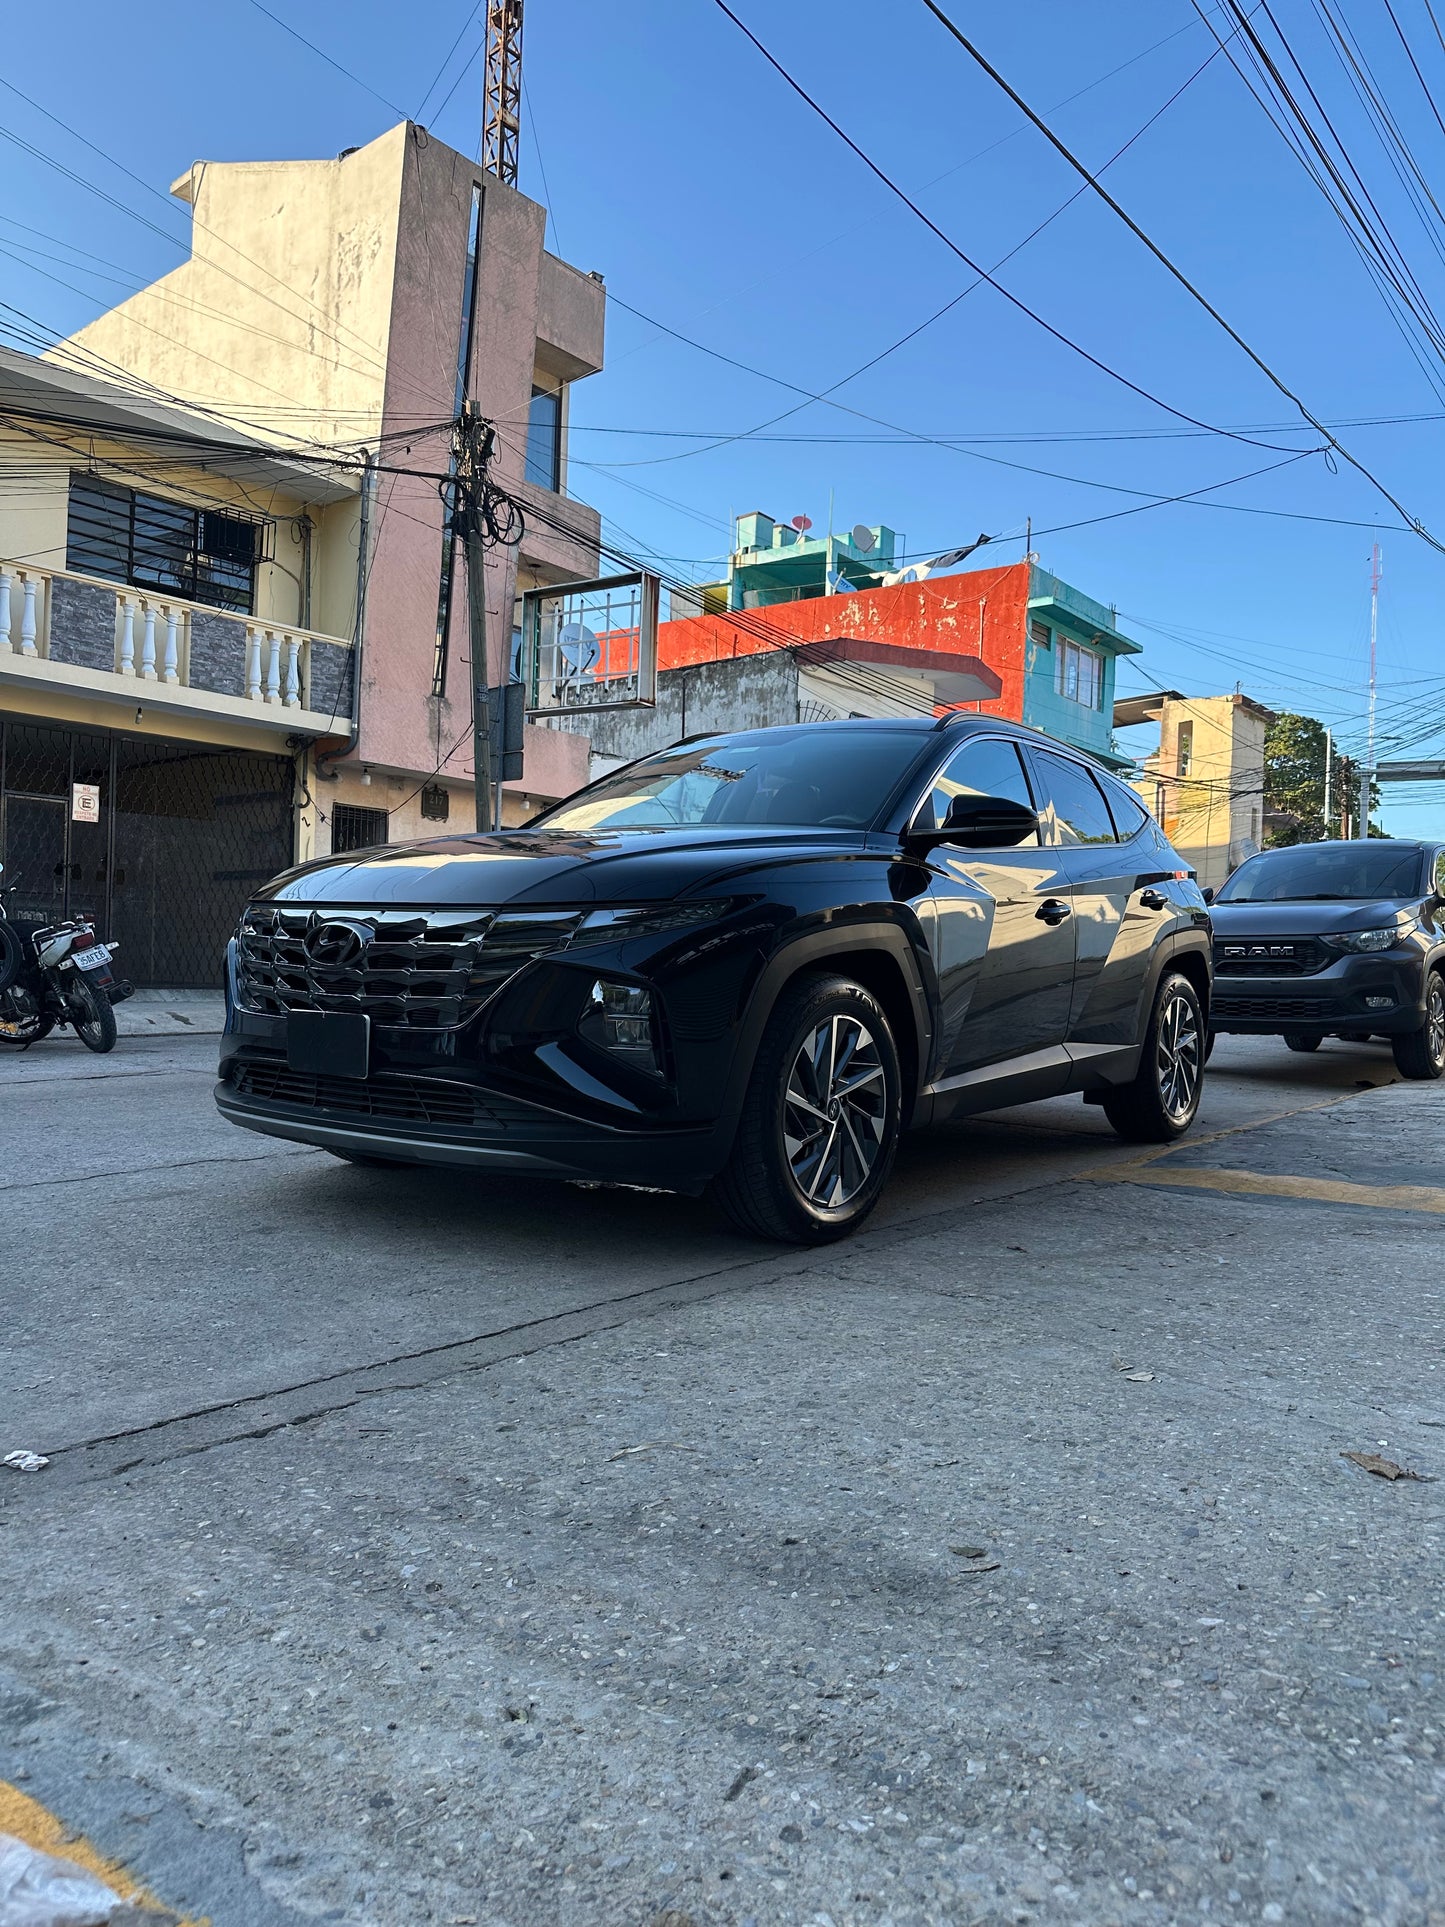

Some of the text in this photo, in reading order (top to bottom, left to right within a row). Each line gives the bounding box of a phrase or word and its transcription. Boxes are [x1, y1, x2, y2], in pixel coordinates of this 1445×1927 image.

[82, 797, 92, 809] E
[429, 795, 444, 805] 217
[1224, 946, 1294, 956] RAM
